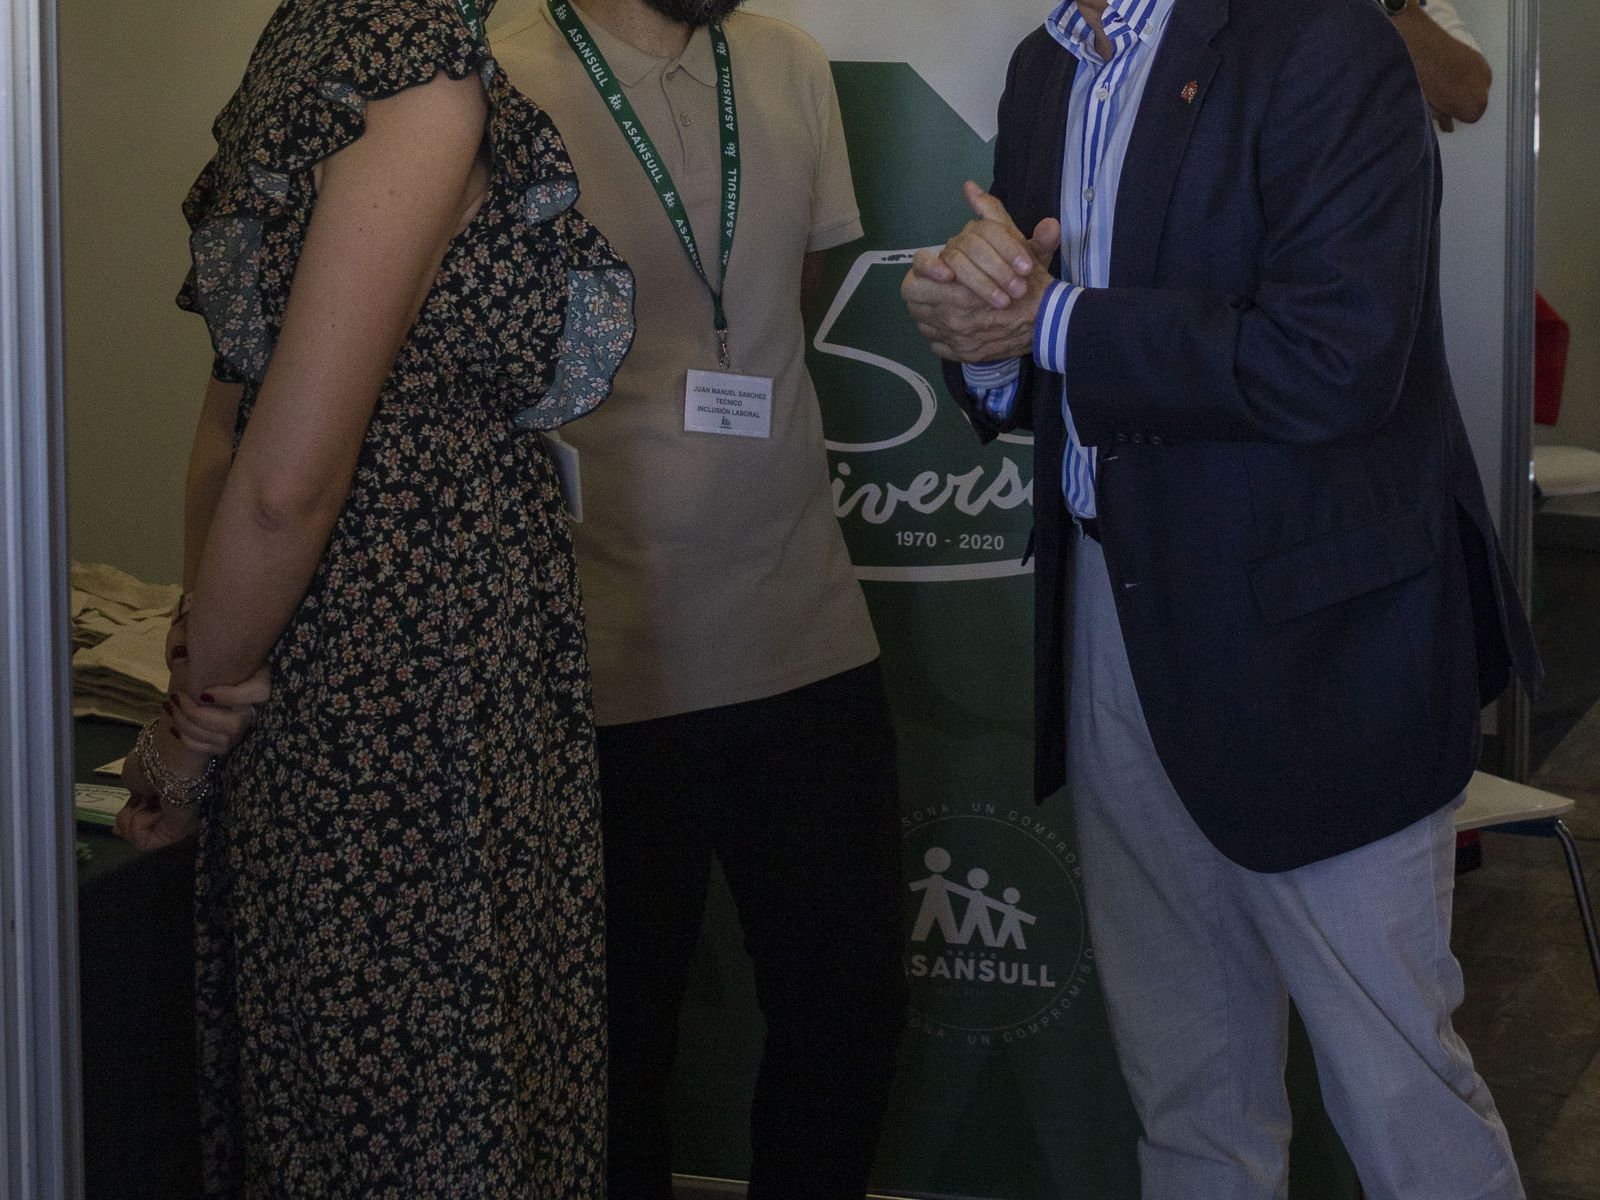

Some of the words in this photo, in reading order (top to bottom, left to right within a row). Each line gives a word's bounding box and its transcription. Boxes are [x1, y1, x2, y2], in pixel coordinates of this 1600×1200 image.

[566, 27, 608, 88] ASANSULL
[622, 119, 663, 184] ASANSULL
[723, 65, 735, 132] ASANSULL
[726, 168, 738, 238] ASANSULL
[693, 386, 710, 394] JUAN
[711, 388, 737, 397] MANUEL
[738, 391, 767, 400] SANCHEZ
[697, 405, 731, 416] INCLUSIÓN
[731, 410, 760, 419] LABORAL
[716, 398, 743, 407] TECNICO
[831, 457, 1034, 525] ivers
[895, 531, 937, 548] 1970
[959, 533, 1005, 551] 2020
[972, 802, 996, 814] UN
[1008, 810, 1082, 879] COMPROM
[967, 1034, 991, 1046] UN
